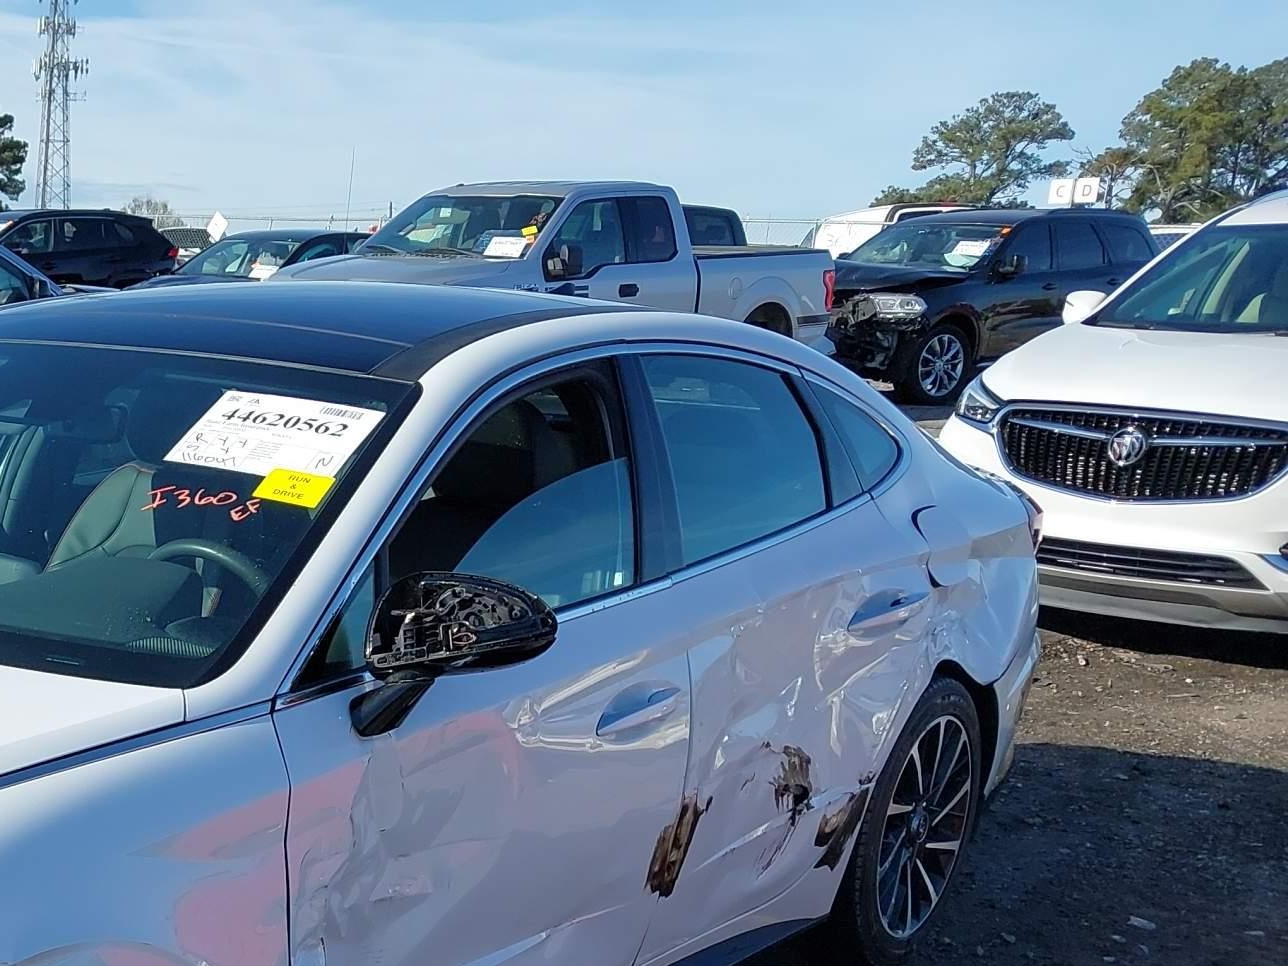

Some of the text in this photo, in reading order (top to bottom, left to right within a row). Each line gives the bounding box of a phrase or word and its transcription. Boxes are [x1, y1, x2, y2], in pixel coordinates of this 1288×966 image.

[1056, 185, 1065, 198] C
[1081, 184, 1093, 197] D
[222, 407, 349, 437] 44620562
[314, 455, 334, 470] N
[288, 474, 312, 484] RUN
[272, 488, 305, 500] DRIVE
